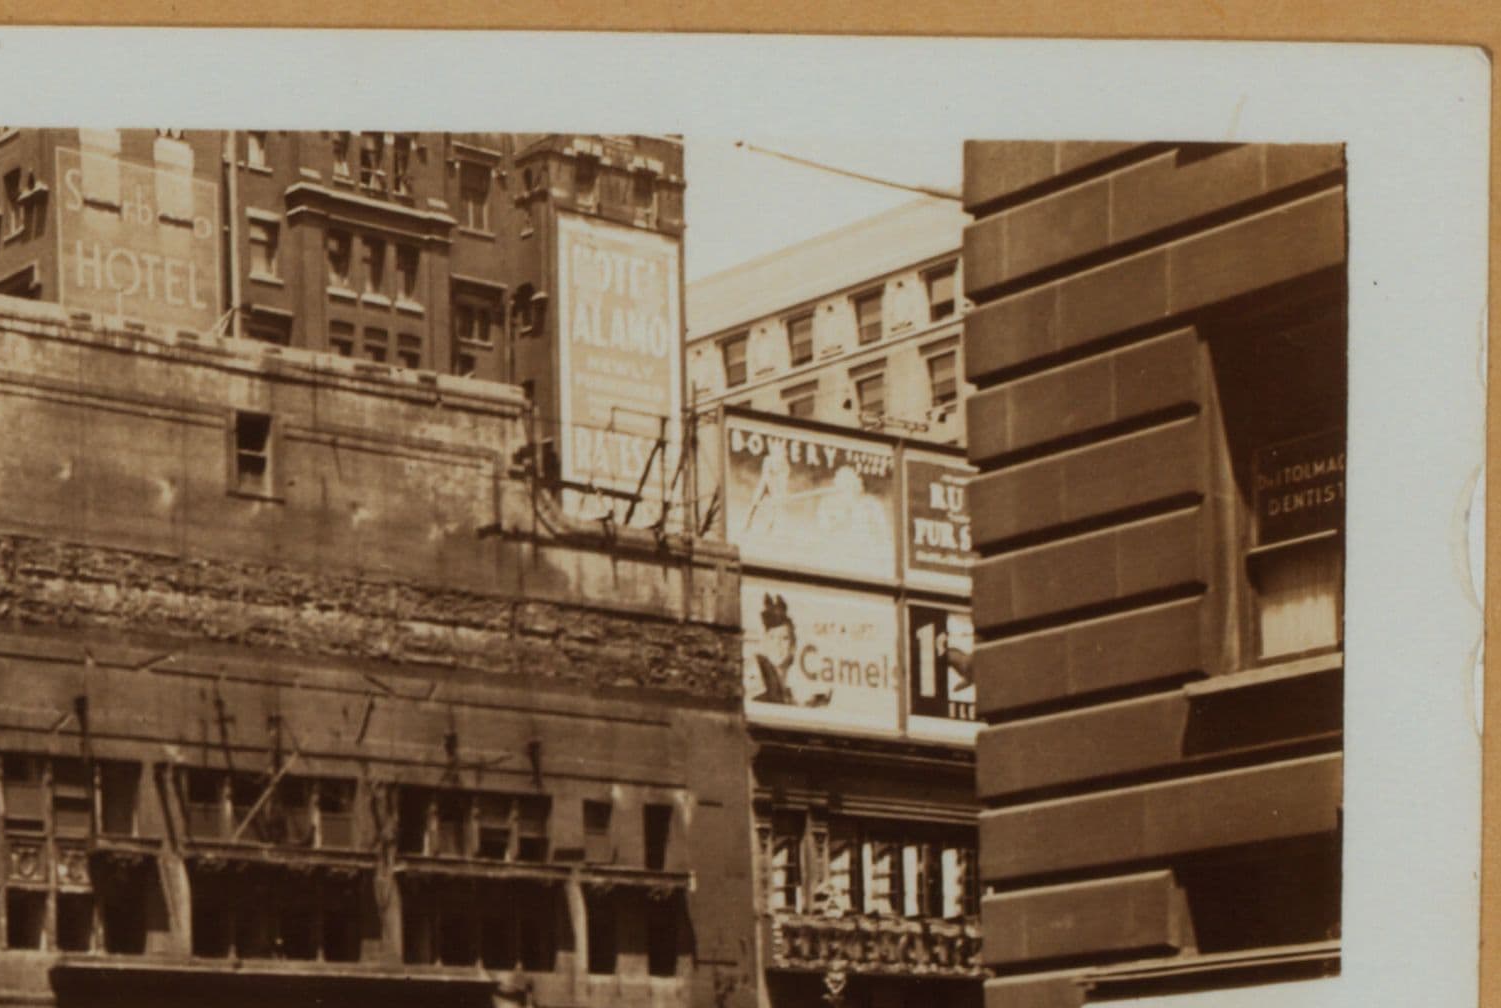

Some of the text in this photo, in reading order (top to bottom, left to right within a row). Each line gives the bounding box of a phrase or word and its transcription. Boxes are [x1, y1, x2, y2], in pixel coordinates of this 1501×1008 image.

[76, 239, 207, 309] HOTEL
[572, 299, 668, 358] ALAMO
[732, 428, 838, 469] BOWERY
